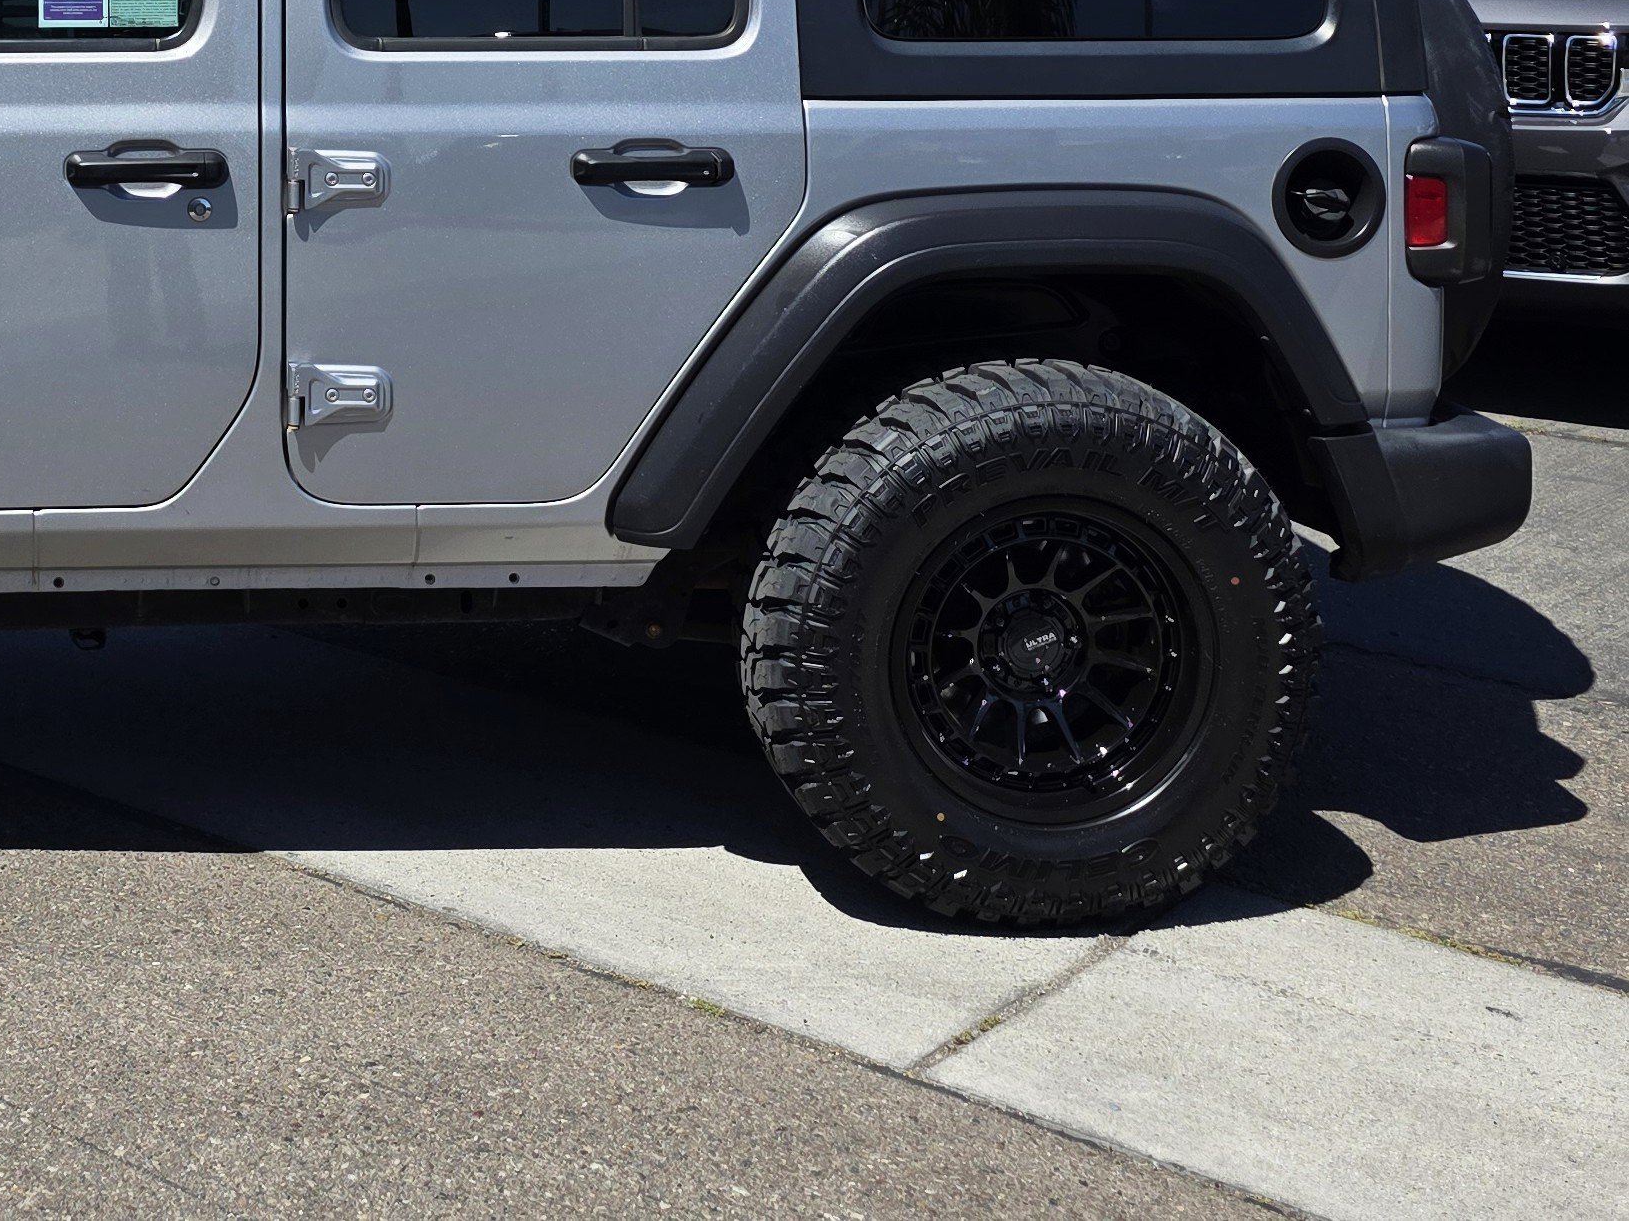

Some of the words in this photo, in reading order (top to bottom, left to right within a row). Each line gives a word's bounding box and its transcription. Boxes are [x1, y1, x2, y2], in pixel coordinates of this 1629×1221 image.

[910, 446, 1123, 529] PREVAIL
[1025, 632, 1058, 649] ULTRA
[938, 834, 1162, 881] CELIMO
